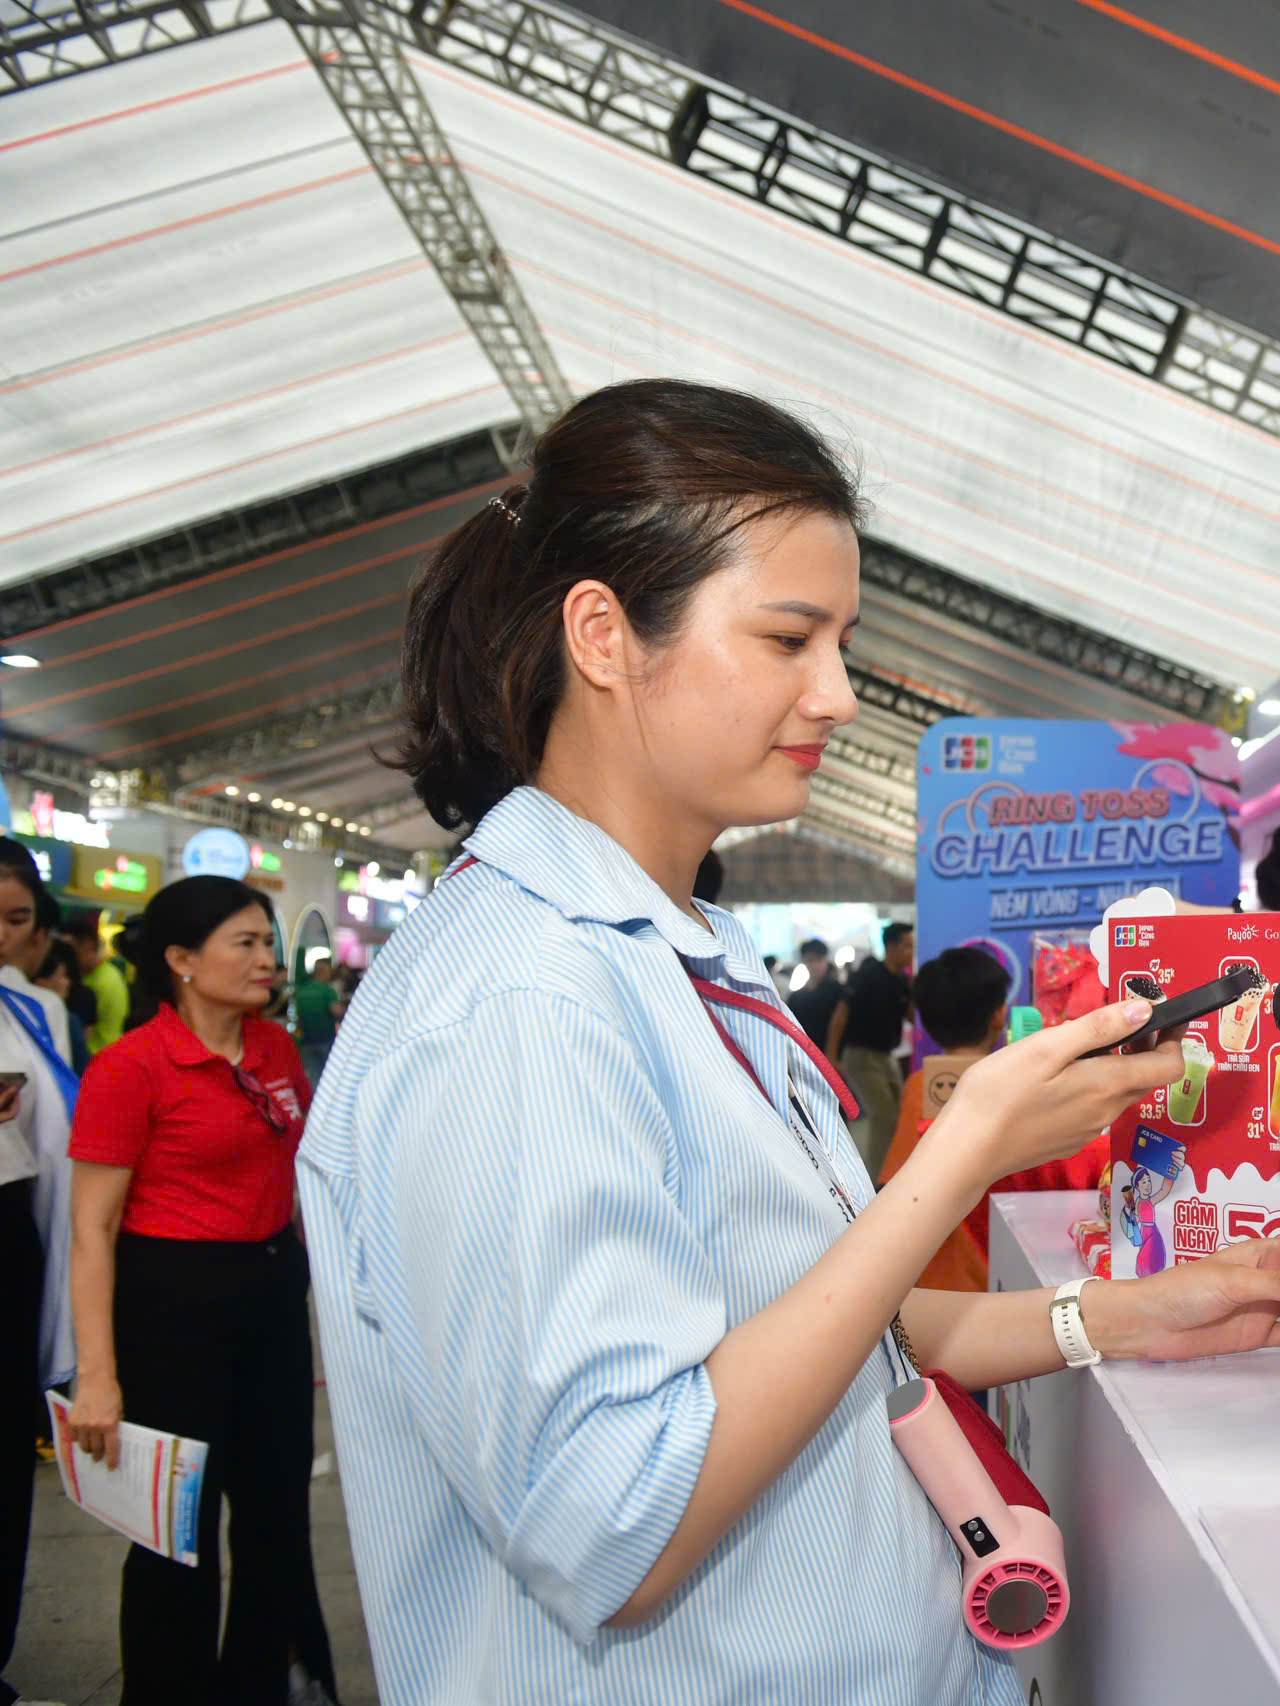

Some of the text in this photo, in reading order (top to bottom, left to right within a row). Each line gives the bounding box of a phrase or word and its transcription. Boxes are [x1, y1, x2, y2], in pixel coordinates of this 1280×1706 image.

[990, 788, 1170, 826] RING TOSS
[932, 818, 1223, 874] CHALLENGE
[1227, 927, 1253, 943] Payoo
[1140, 1103, 1166, 1119] 33.5k
[1247, 1122, 1265, 1139] 31k
[1176, 1200, 1215, 1227] GIẢM
[1176, 1228, 1216, 1251] NGAY
